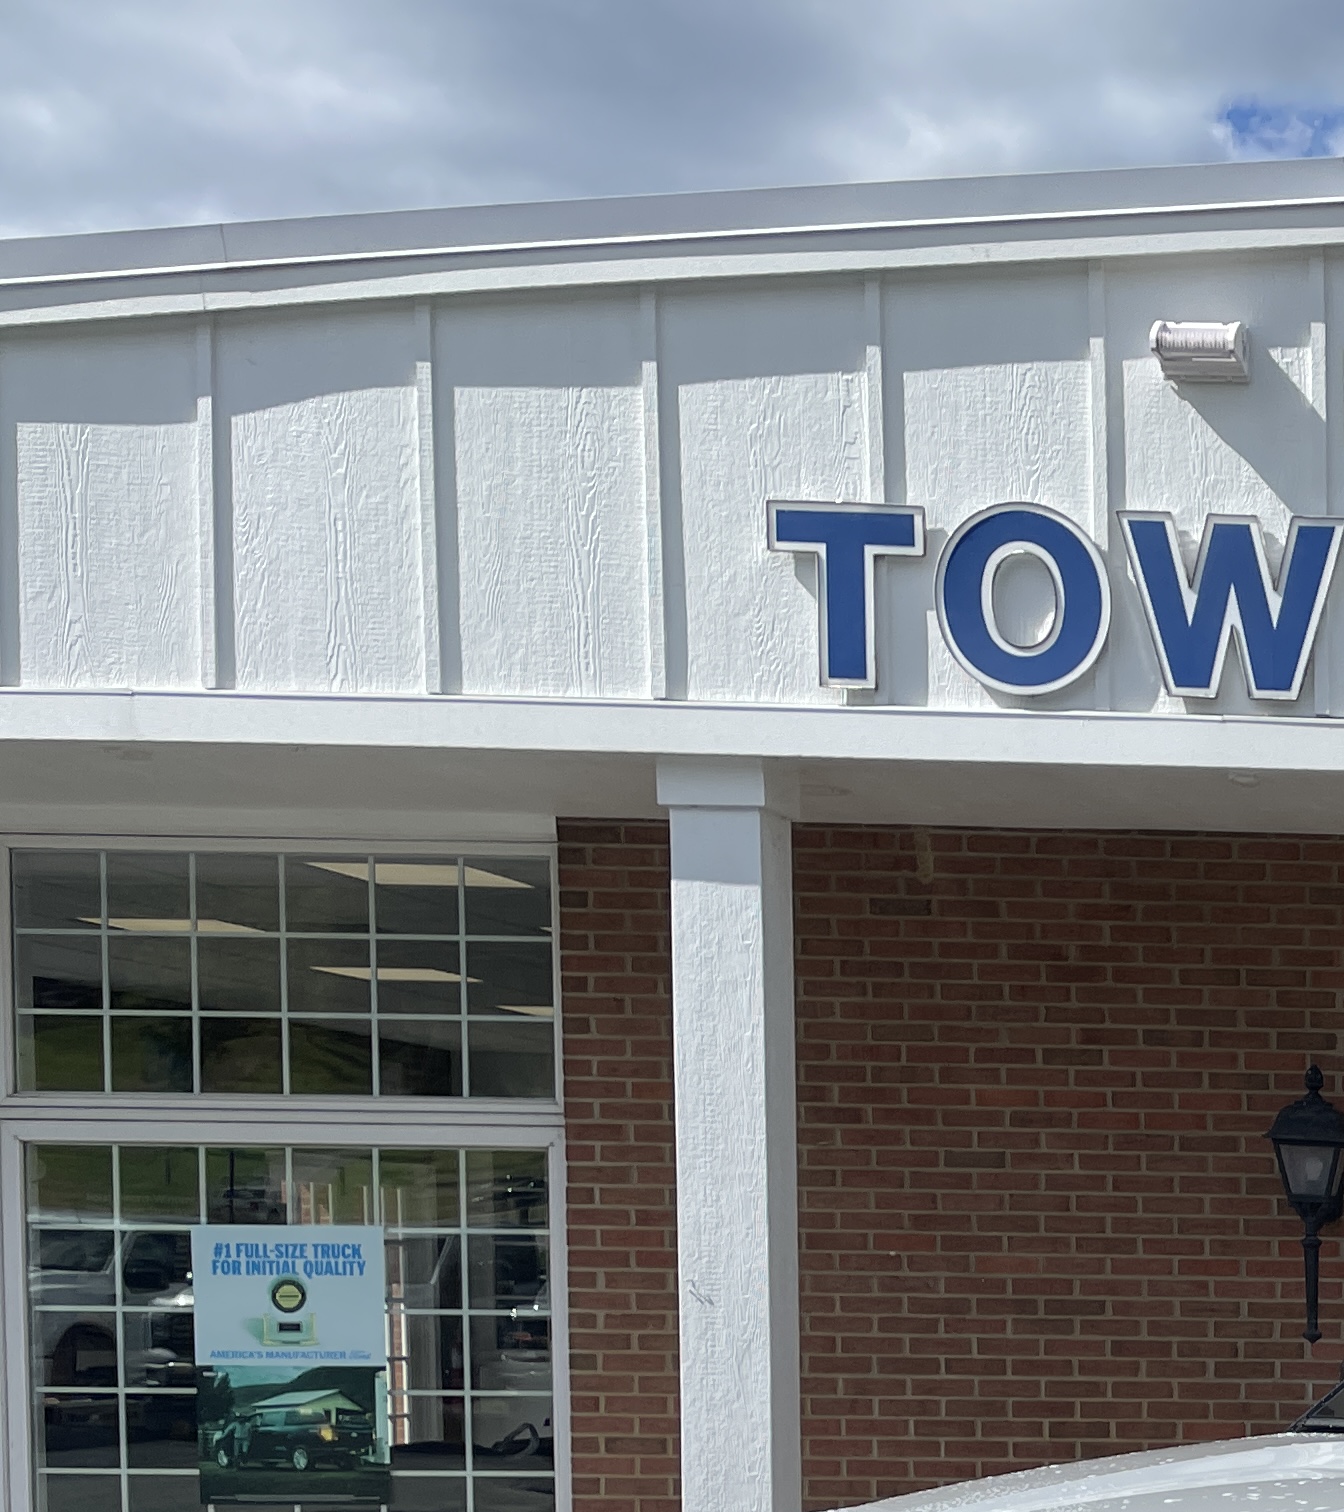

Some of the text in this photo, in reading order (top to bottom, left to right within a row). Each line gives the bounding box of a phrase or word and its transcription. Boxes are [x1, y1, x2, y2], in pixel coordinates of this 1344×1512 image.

[213, 1242, 362, 1260] #1 FULL-SIZE TRUCK
[211, 1259, 366, 1280] FOR INITIAL QUALITY
[210, 1350, 264, 1360] AMERICA'S
[265, 1350, 347, 1360] MANUFACTURER
